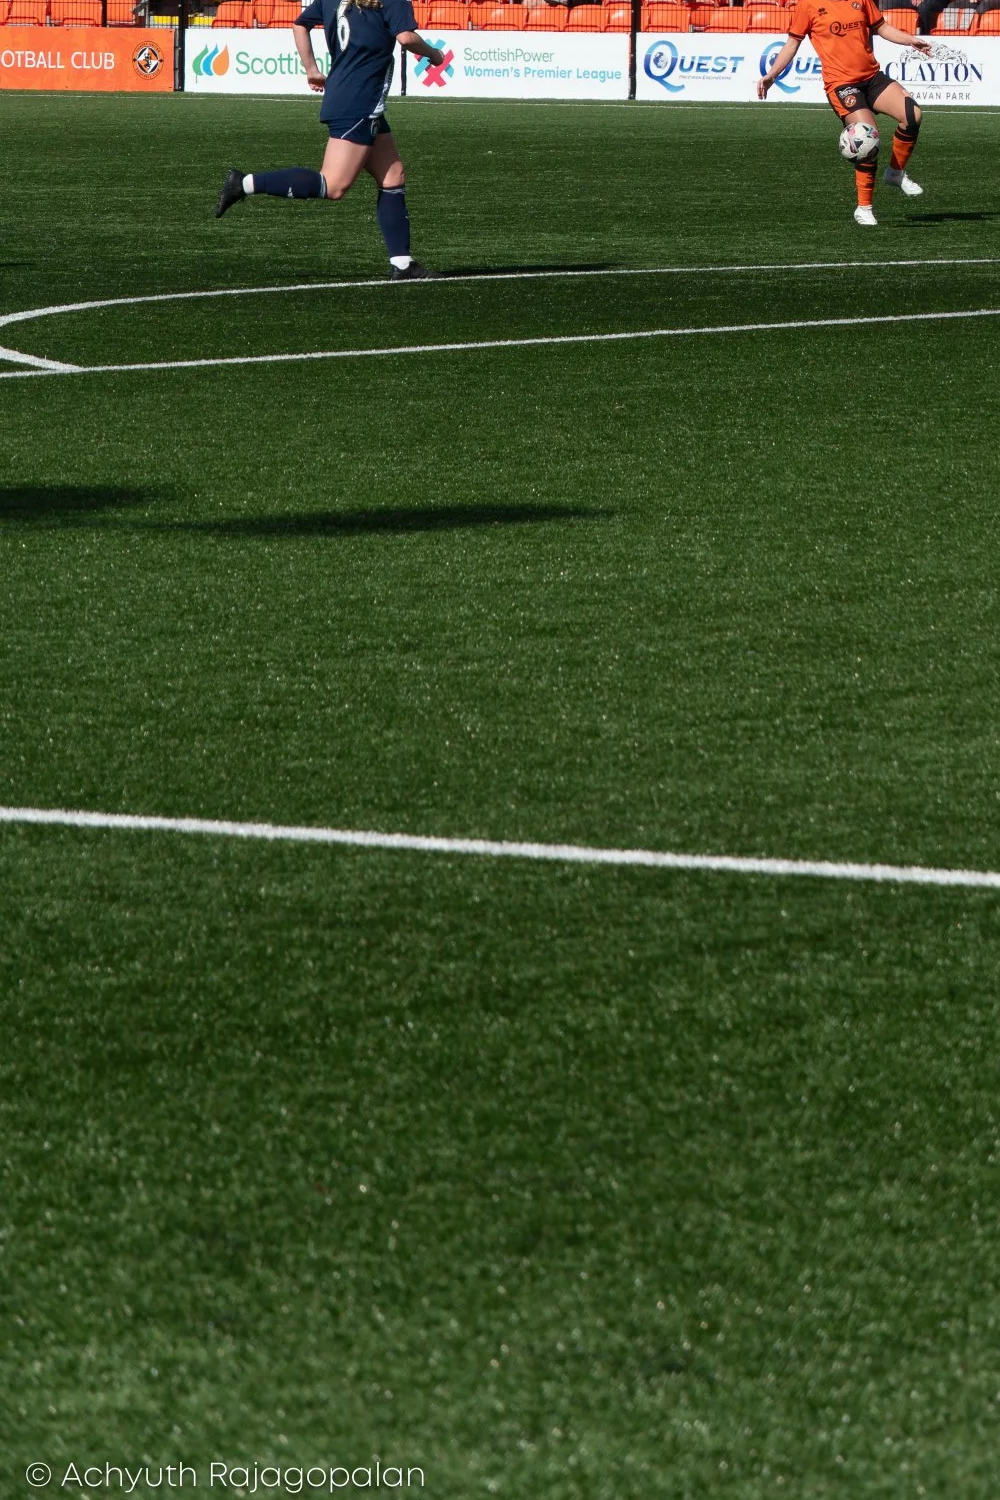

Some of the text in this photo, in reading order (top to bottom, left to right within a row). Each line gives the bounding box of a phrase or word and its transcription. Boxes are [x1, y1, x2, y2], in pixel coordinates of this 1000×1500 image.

[336, 0, 350, 52] 6
[0, 50, 116, 70] OTBALL CLUB
[464, 48, 554, 63] ScottishPower
[464, 65, 622, 84] Women's Premier League
[885, 61, 983, 82] CLAYTON
[946, 92, 971, 100] PARK
